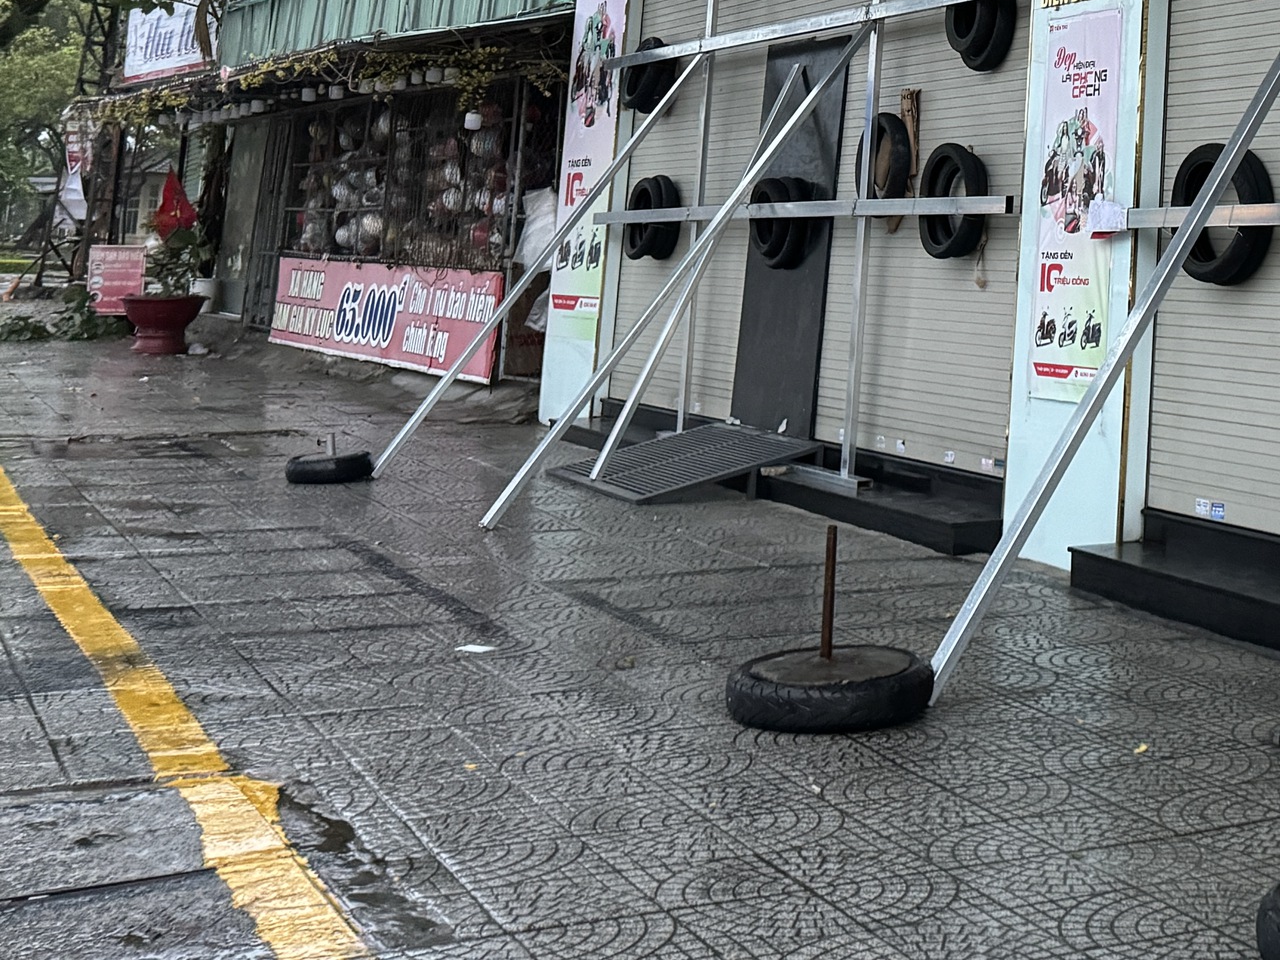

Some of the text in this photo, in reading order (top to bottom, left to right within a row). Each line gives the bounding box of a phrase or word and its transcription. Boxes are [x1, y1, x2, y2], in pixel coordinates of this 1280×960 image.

[1041, 249, 1073, 262] TẶNG ĐẾN
[408, 280, 428, 316] Cho
[445, 280, 467, 321] bảo
[402, 320, 428, 356] chính
